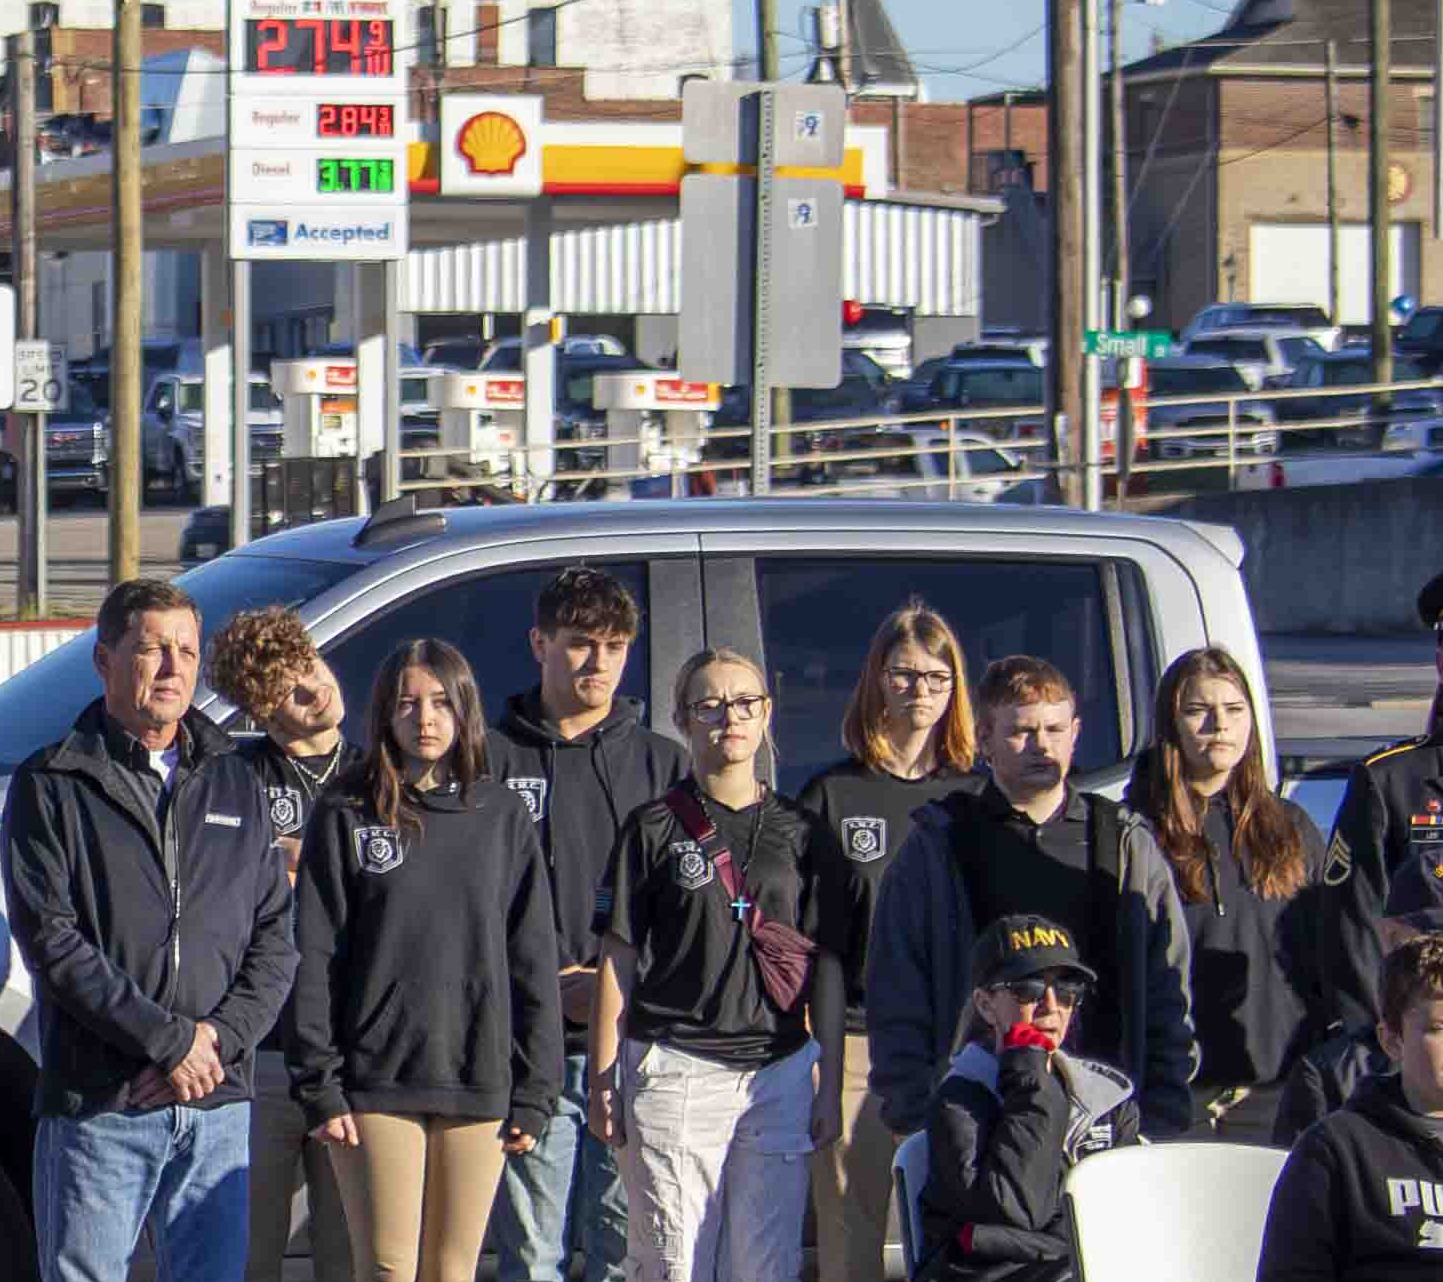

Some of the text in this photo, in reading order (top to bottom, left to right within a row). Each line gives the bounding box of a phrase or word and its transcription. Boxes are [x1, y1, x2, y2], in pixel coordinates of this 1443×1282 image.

[294, 221, 391, 245] Accepted
[20, 378, 62, 403] 20
[1011, 925, 1070, 951] NAVY
